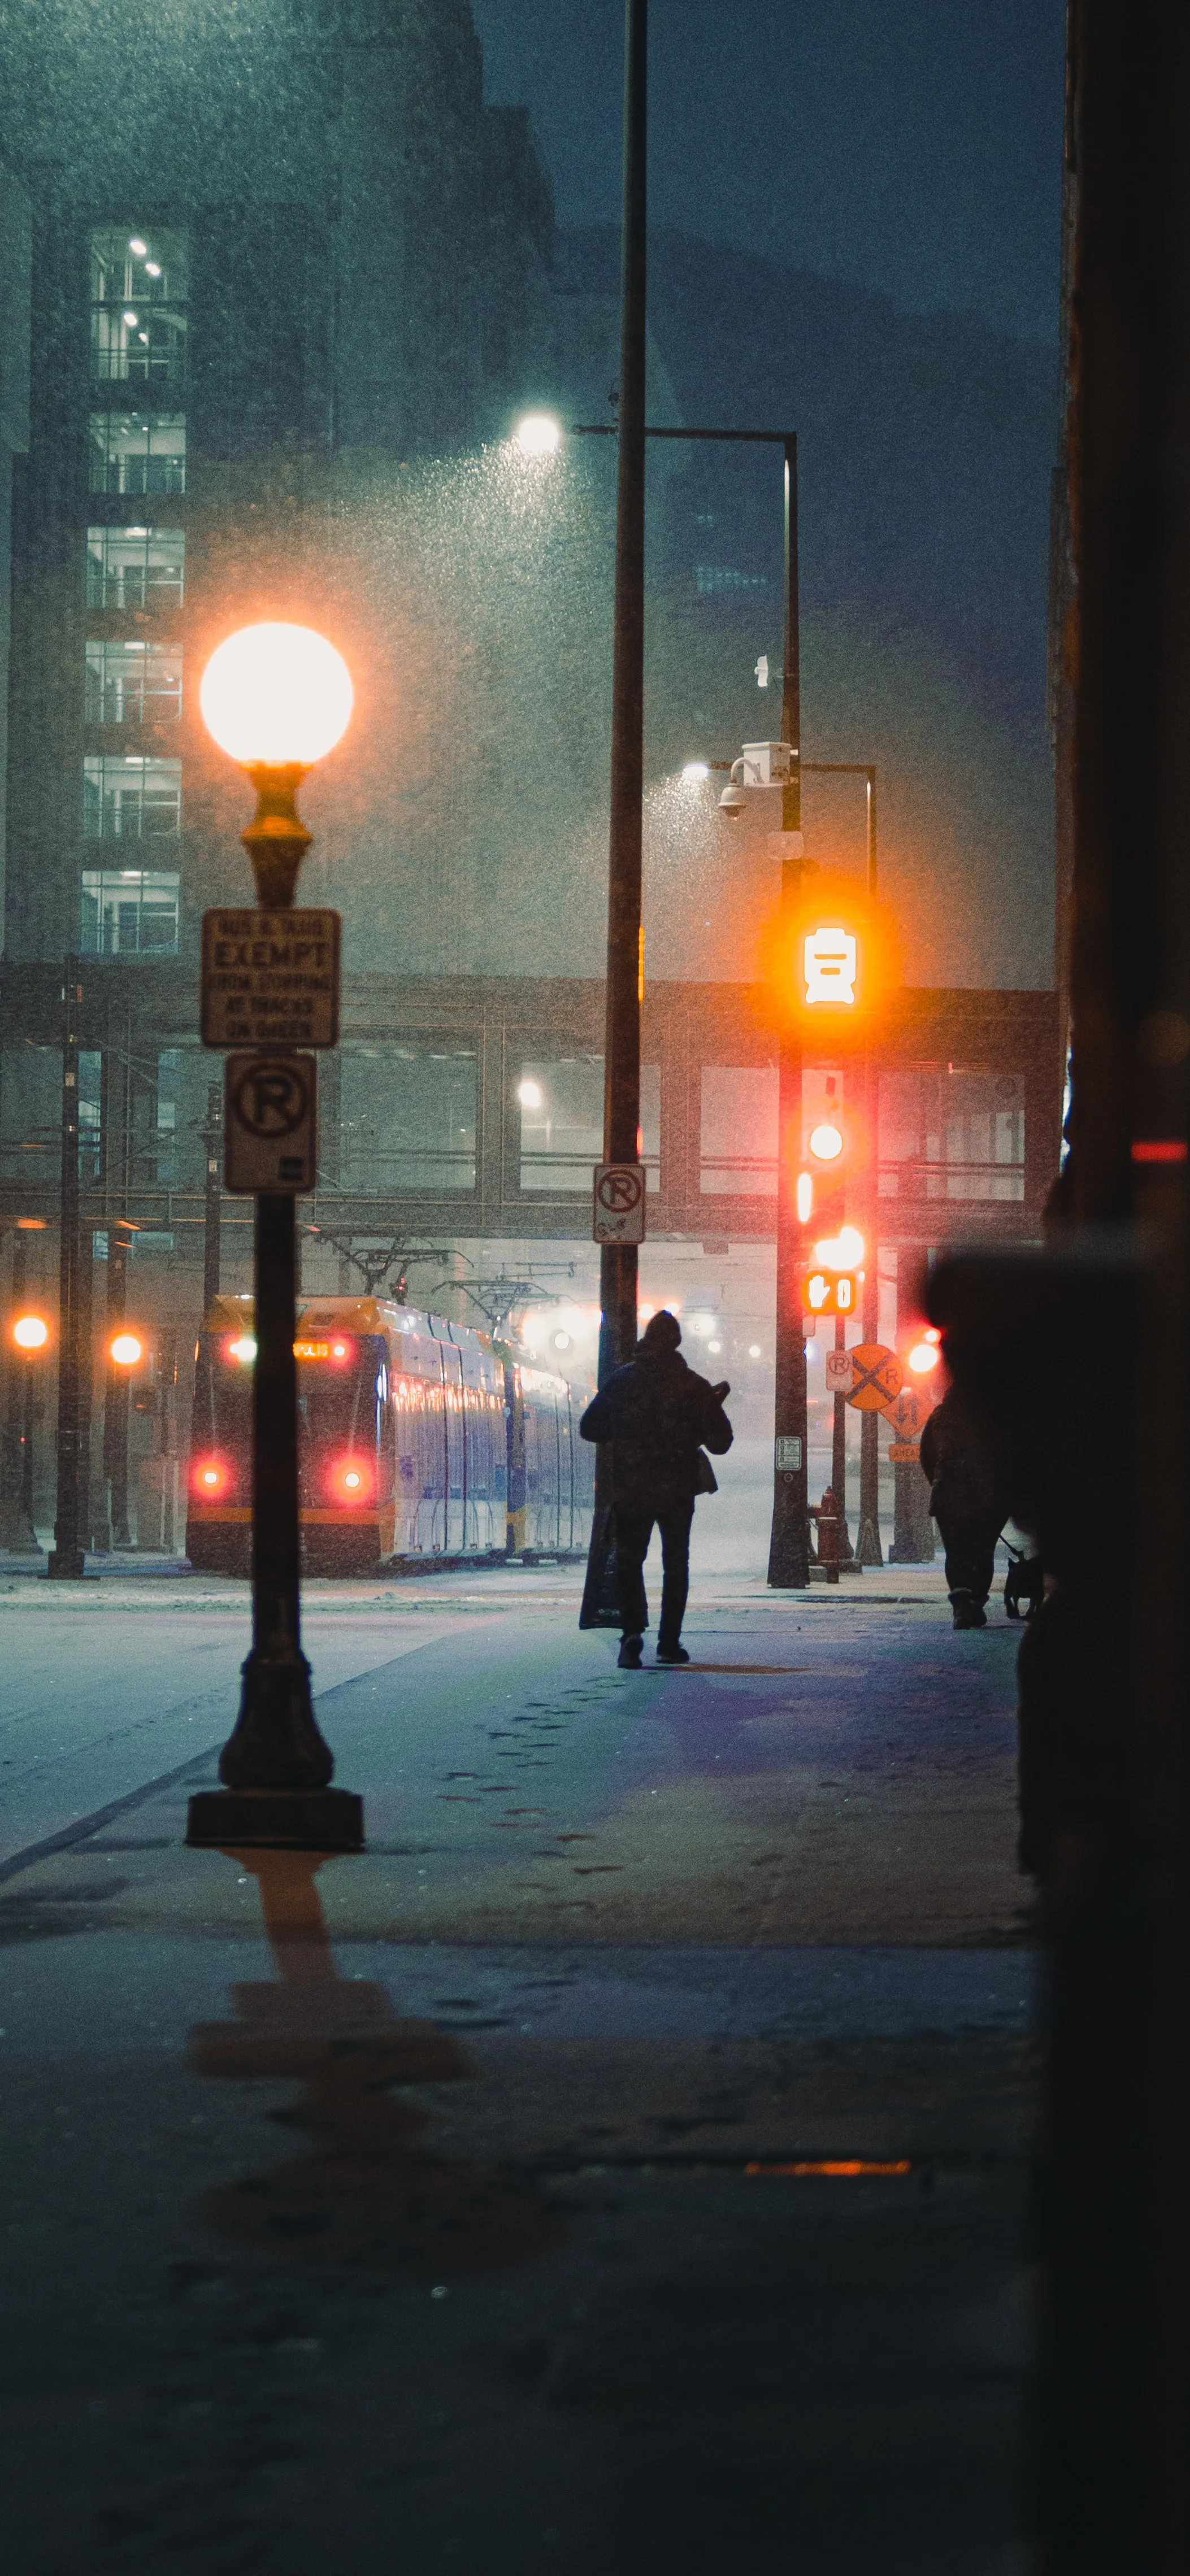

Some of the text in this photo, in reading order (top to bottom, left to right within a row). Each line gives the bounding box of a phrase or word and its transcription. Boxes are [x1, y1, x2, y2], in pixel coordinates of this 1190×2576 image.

[215, 941, 327, 967] EXEMPT
[226, 1020, 312, 1039] ON GREEN
[837, 1279, 850, 1308] 0
[293, 1343, 328, 1356] POLIS
[886, 1369, 898, 1384] R
